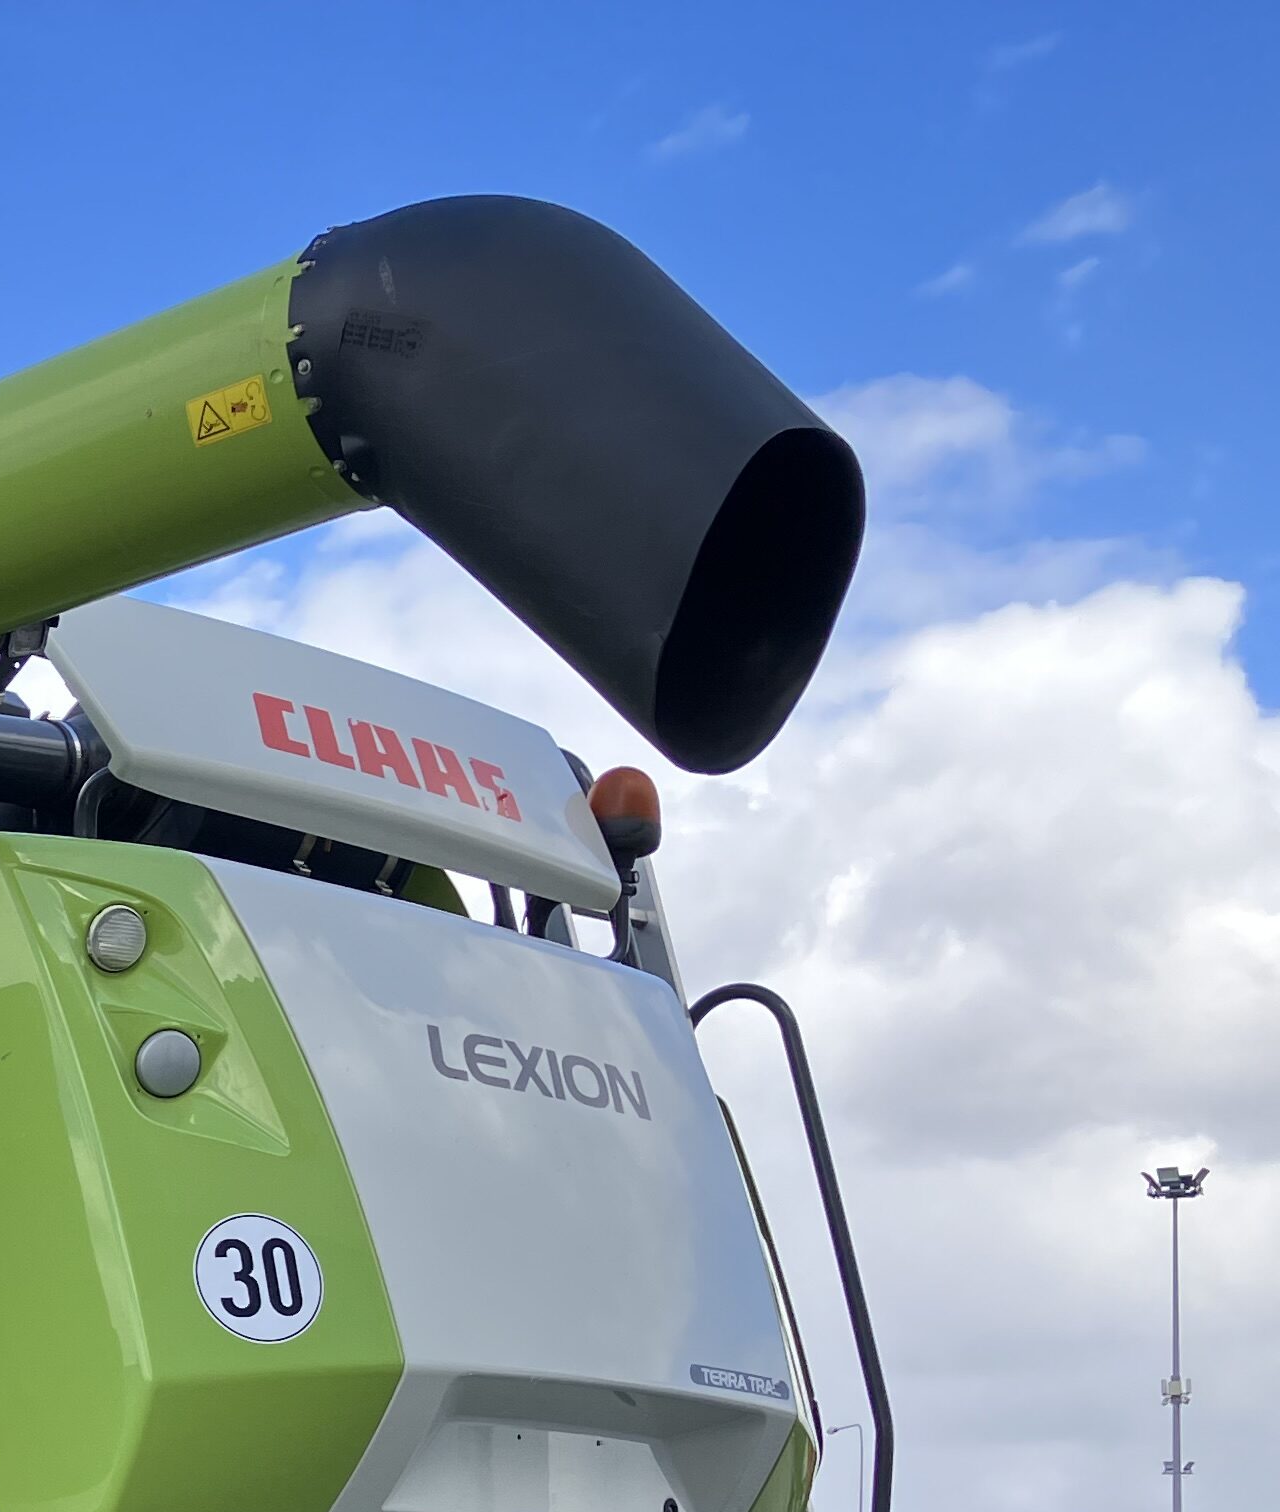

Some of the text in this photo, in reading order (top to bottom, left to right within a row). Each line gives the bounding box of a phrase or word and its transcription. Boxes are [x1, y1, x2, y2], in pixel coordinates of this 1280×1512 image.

[252, 692, 522, 822] CLAAS
[426, 1024, 652, 1121] LEXION
[214, 1238, 304, 1318] 30
[701, 1368, 748, 1391] TERRA
